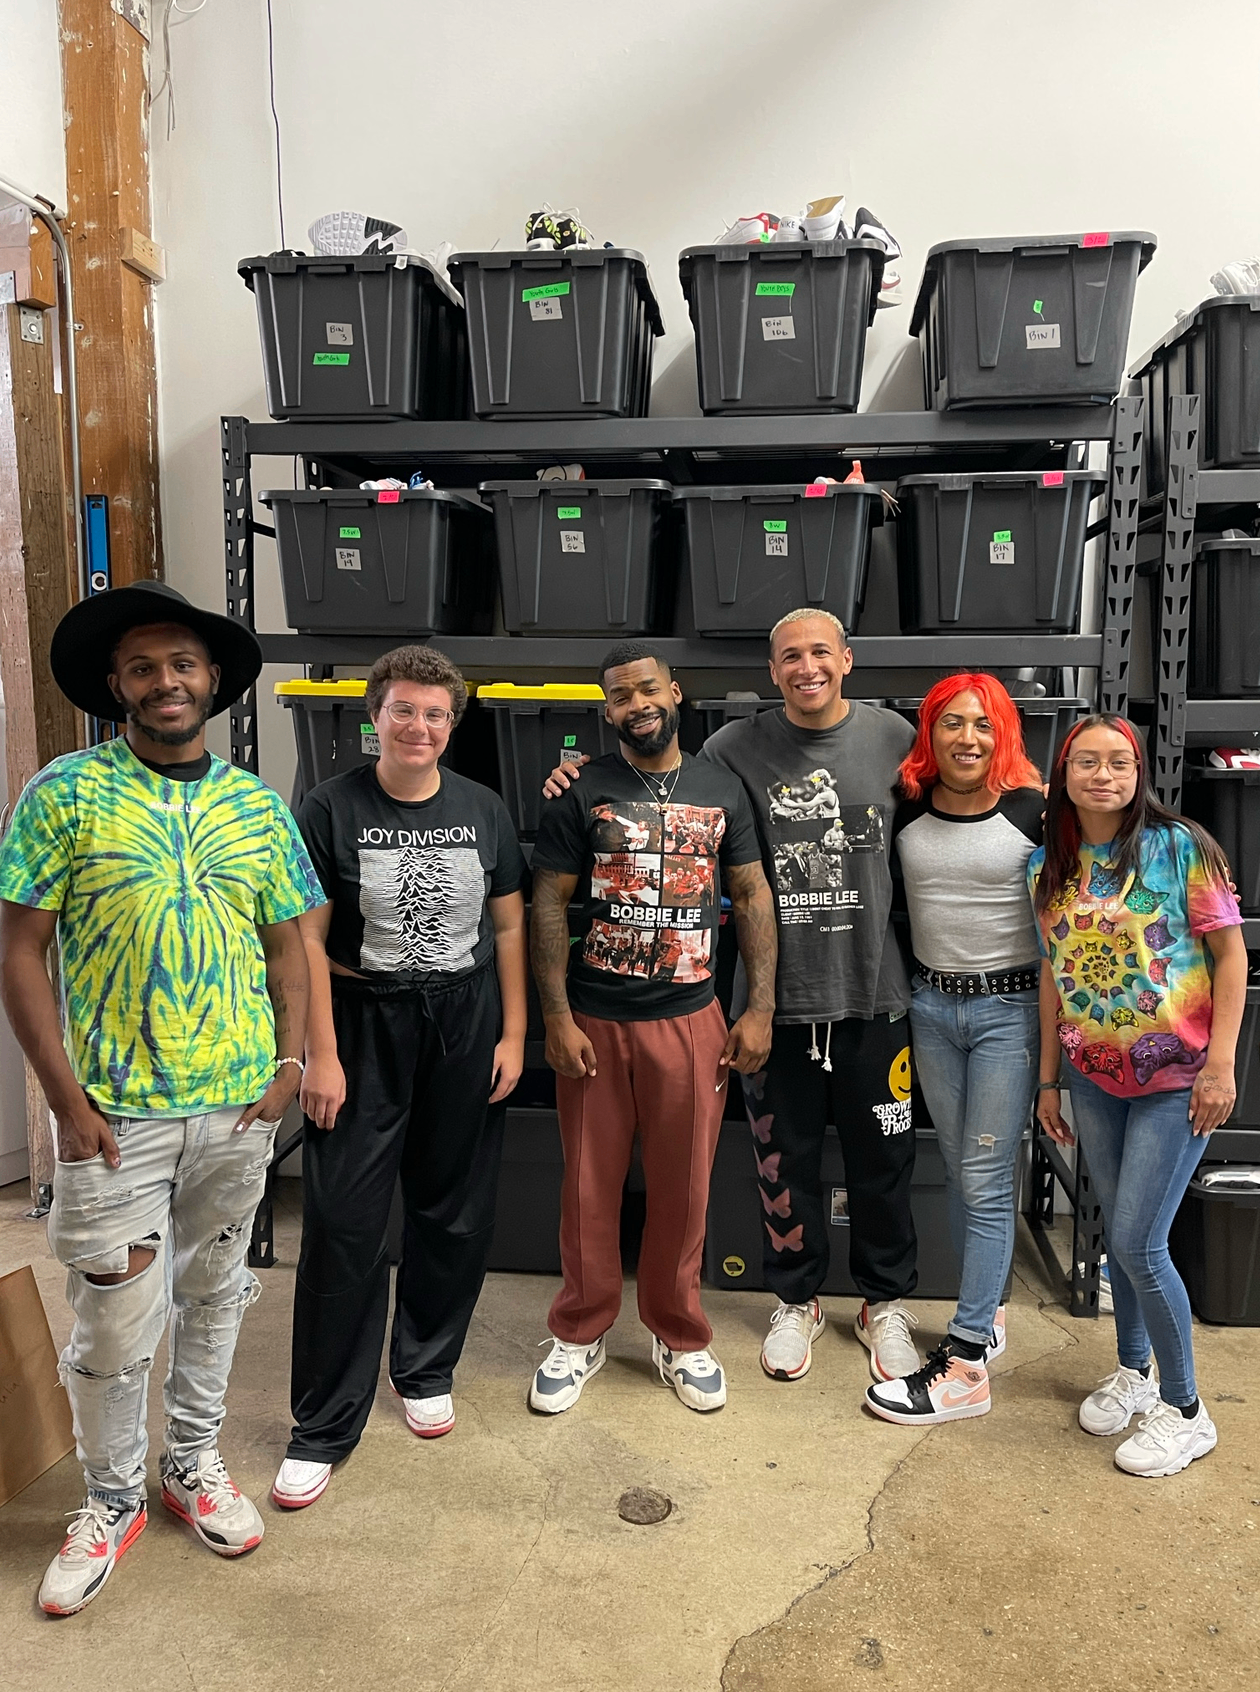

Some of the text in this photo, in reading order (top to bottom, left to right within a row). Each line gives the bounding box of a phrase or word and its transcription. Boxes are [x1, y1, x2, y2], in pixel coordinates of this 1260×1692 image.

[534, 300, 549, 309] BIN
[565, 534, 578, 542] BIN
[567, 543, 578, 551] 56
[771, 544, 782, 554] 14
[993, 543, 1010, 553] BIN
[339, 551, 355, 560] BIN
[995, 552, 1005, 560] 17
[343, 559, 353, 567] 19
[368, 745, 380, 754] 28
[357, 825, 477, 847] JOY DIVISION
[778, 890, 859, 908] BOBBIE LEE
[1104, 902, 1119, 910] LEE
[609, 903, 702, 923] BOBBIE LEE
[618, 918, 655, 928] REMEMBER
[669, 921, 694, 929] MISSION
